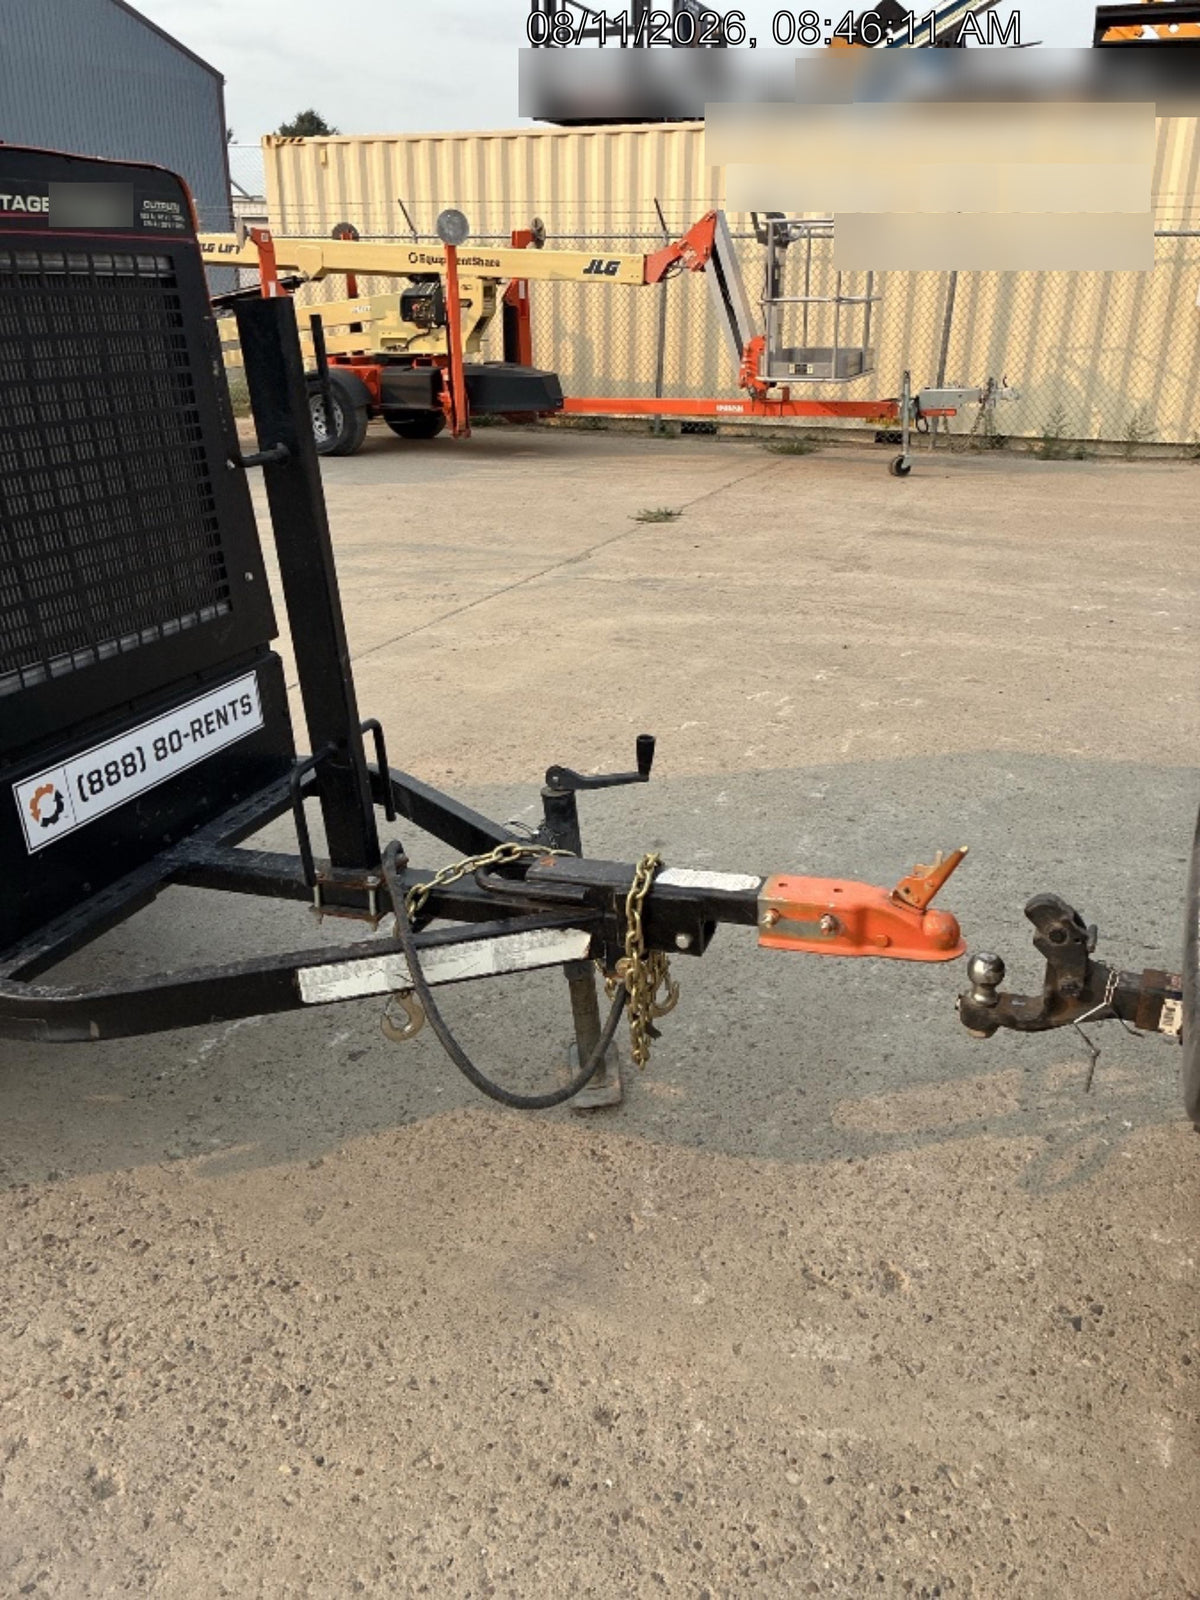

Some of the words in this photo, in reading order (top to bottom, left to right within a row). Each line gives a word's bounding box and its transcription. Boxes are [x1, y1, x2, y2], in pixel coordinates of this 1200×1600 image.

[419, 253, 501, 267] EquipentShare
[583, 259, 621, 276] JLG
[77, 746, 146, 802] (888)
[152, 694, 253, 762] 80-RENTS
